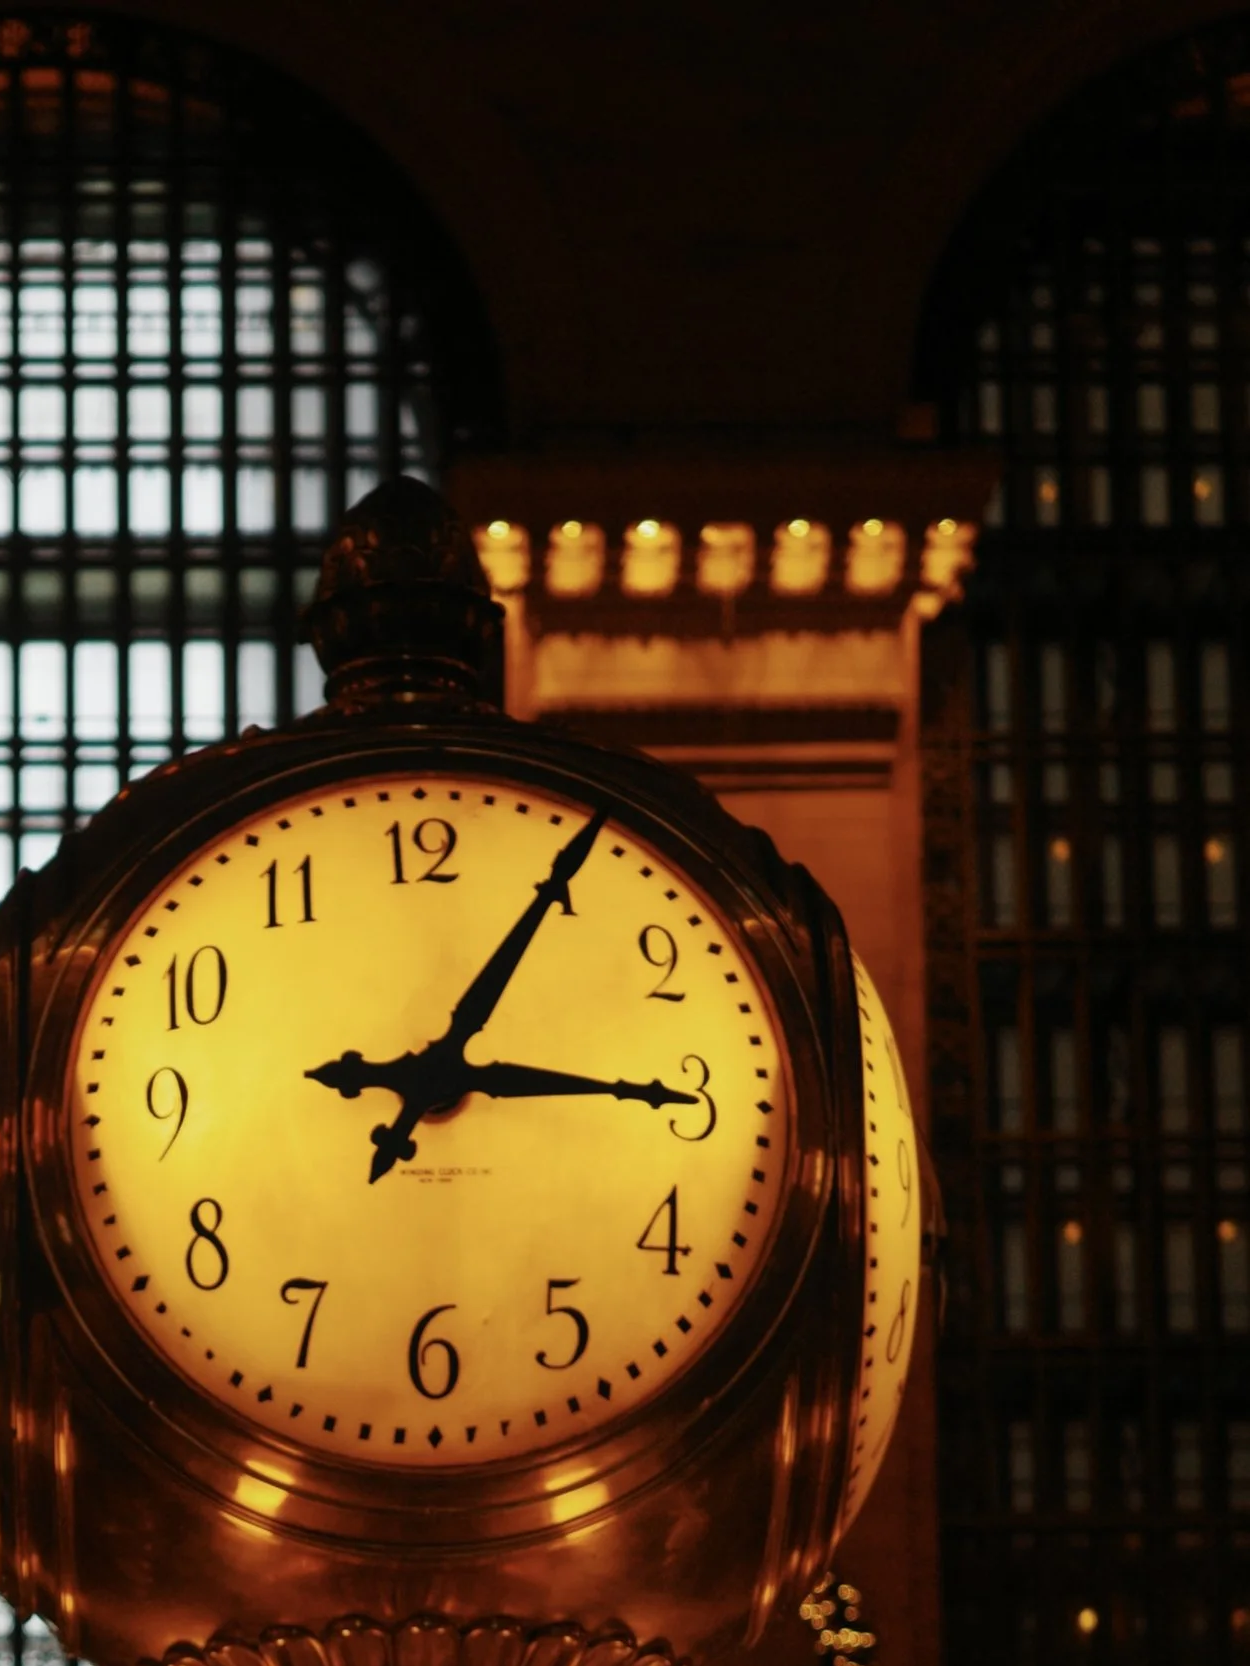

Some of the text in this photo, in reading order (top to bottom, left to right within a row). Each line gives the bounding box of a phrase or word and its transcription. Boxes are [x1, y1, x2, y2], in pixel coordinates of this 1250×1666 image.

[261, 855, 316, 928] 11
[385, 818, 459, 884] 12
[166, 946, 227, 1031] 10
[638, 925, 686, 1003] 2
[146, 1068, 189, 1161] 9
[668, 1055, 717, 1141] 3
[185, 1198, 230, 1291] 8
[636, 1185, 693, 1276] 4
[279, 1278, 329, 1370] 7
[408, 1304, 460, 1400] 6
[535, 1278, 590, 1371] 5
